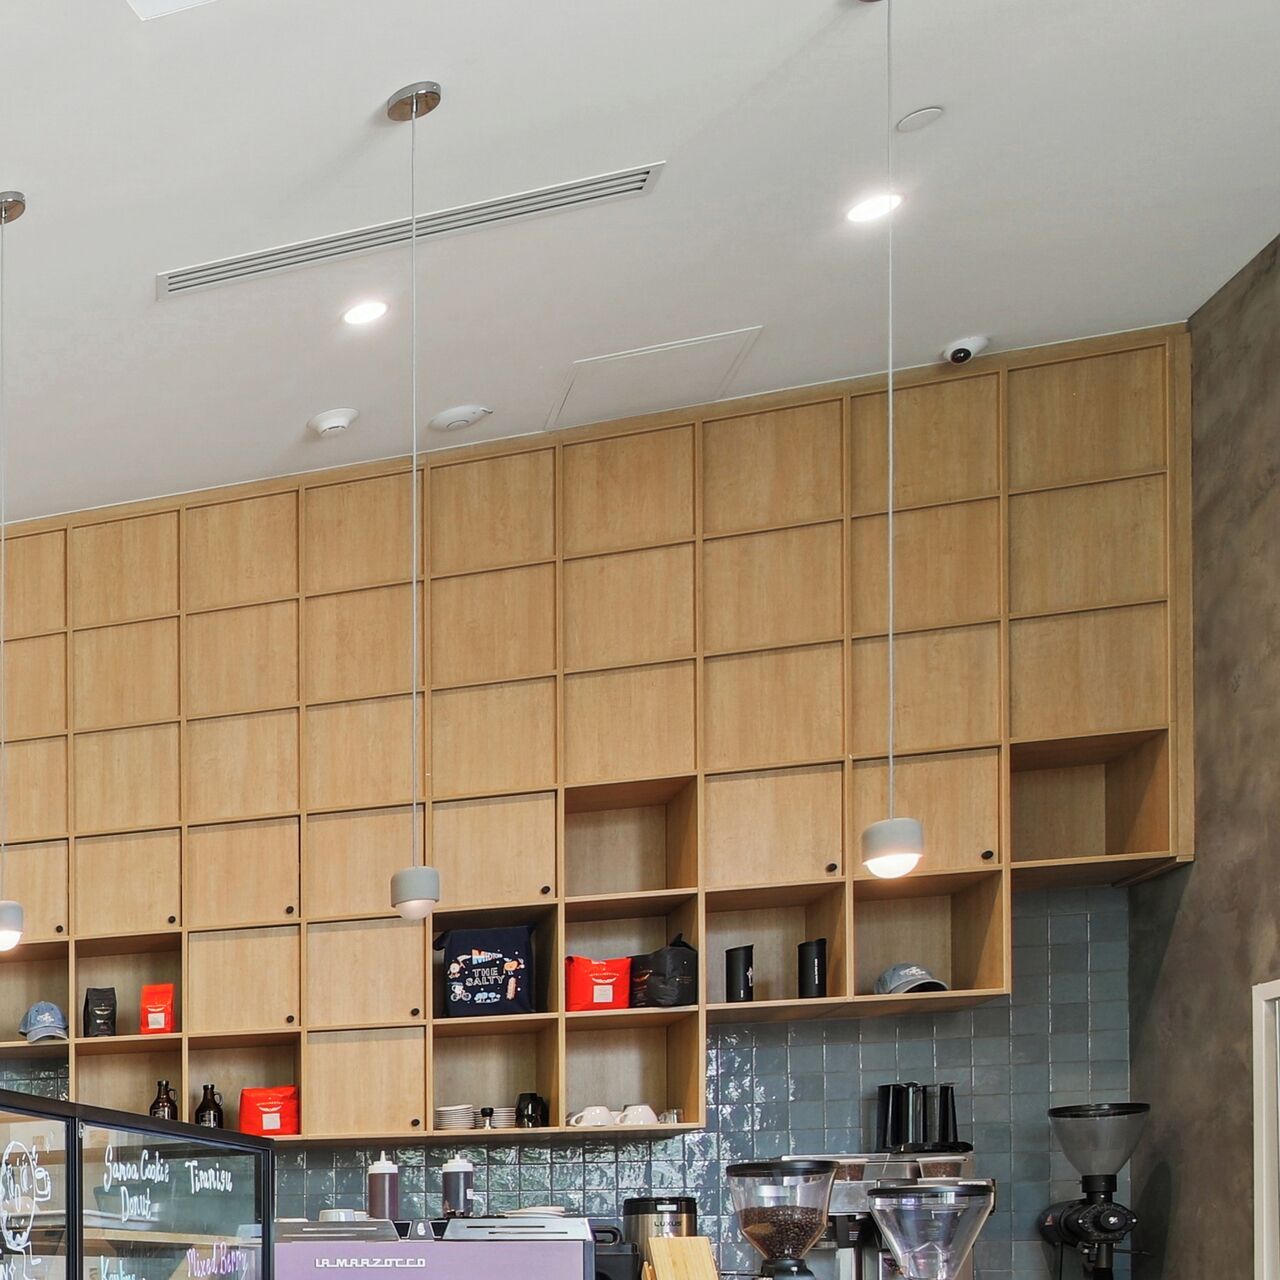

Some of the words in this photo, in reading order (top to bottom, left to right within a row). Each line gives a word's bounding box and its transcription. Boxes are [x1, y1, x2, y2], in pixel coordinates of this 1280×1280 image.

[465, 975, 506, 986] SALTY
[472, 967, 498, 977] THE
[104, 1144, 139, 1192] Samoa
[140, 1150, 170, 1183] Cookie
[121, 1186, 151, 1223] Donut
[186, 1242, 217, 1278] Mixed
[315, 1258, 329, 1268] LA
[336, 1258, 426, 1268] MARZOCCO
